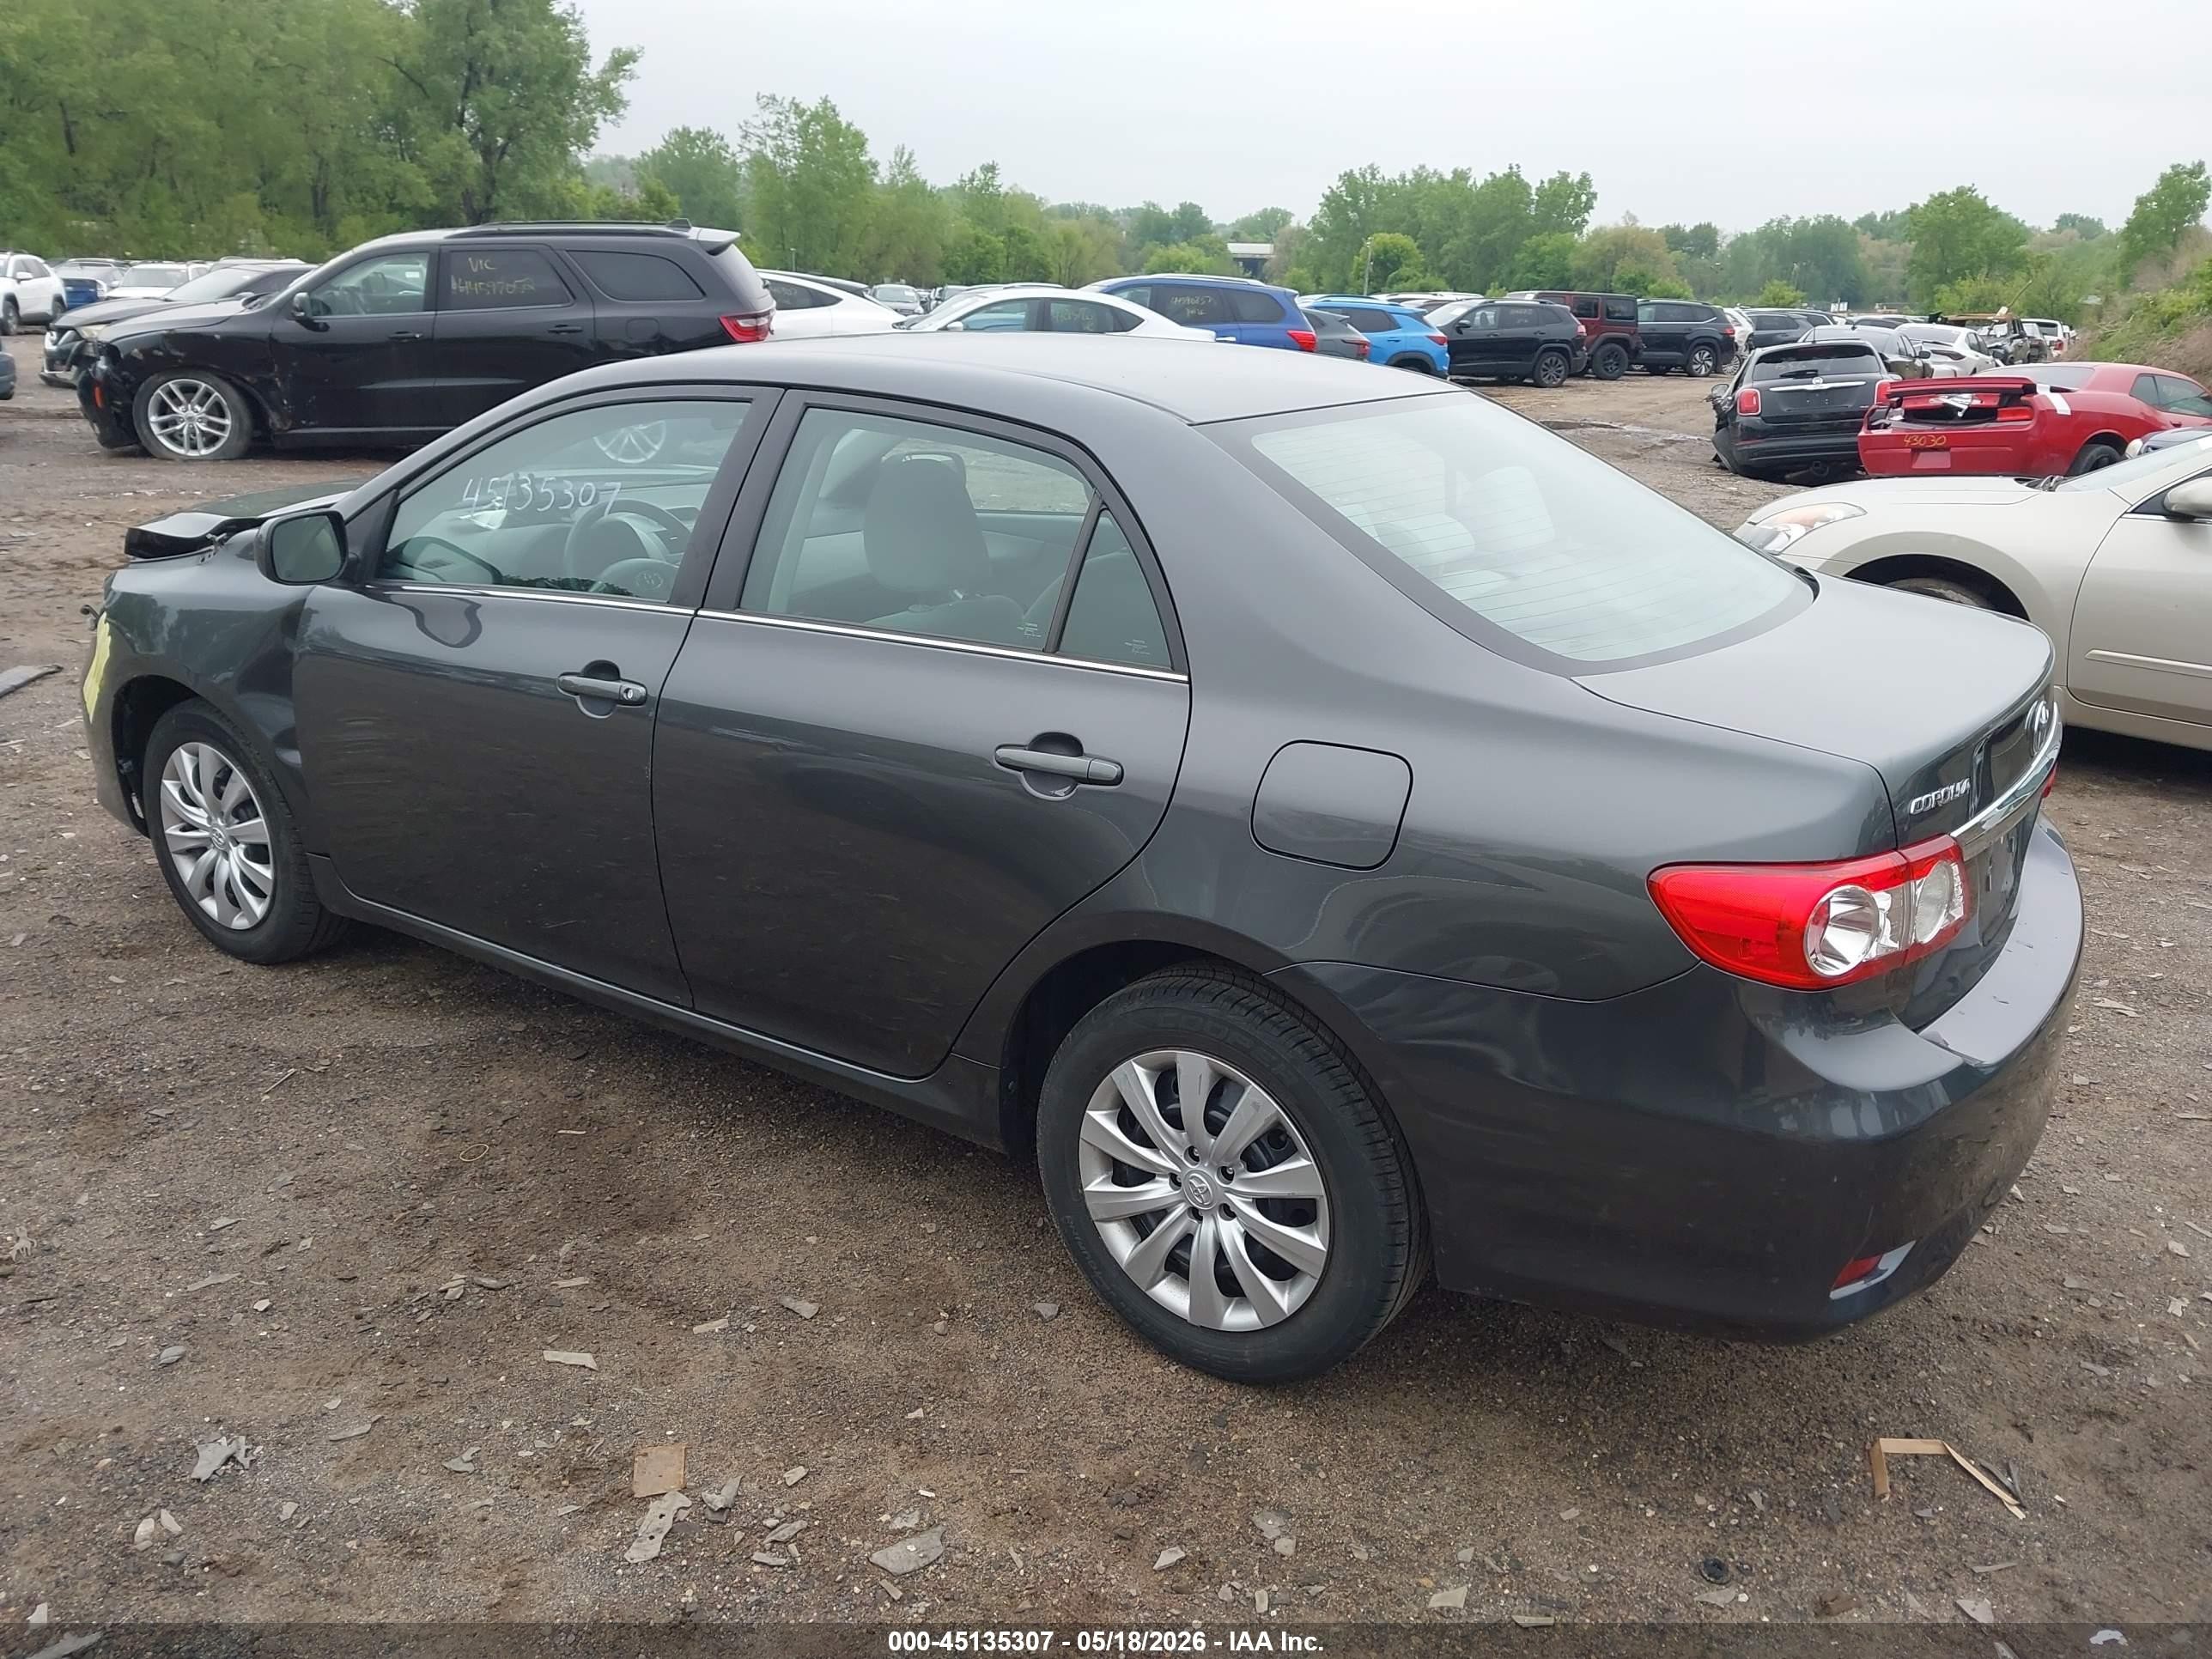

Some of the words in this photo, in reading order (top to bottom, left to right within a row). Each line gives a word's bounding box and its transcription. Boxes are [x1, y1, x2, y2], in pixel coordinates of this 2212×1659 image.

[1903, 434, 1948, 447] 43030
[461, 475, 623, 517] 45135307
[1909, 777, 1971, 815] COROLLA
